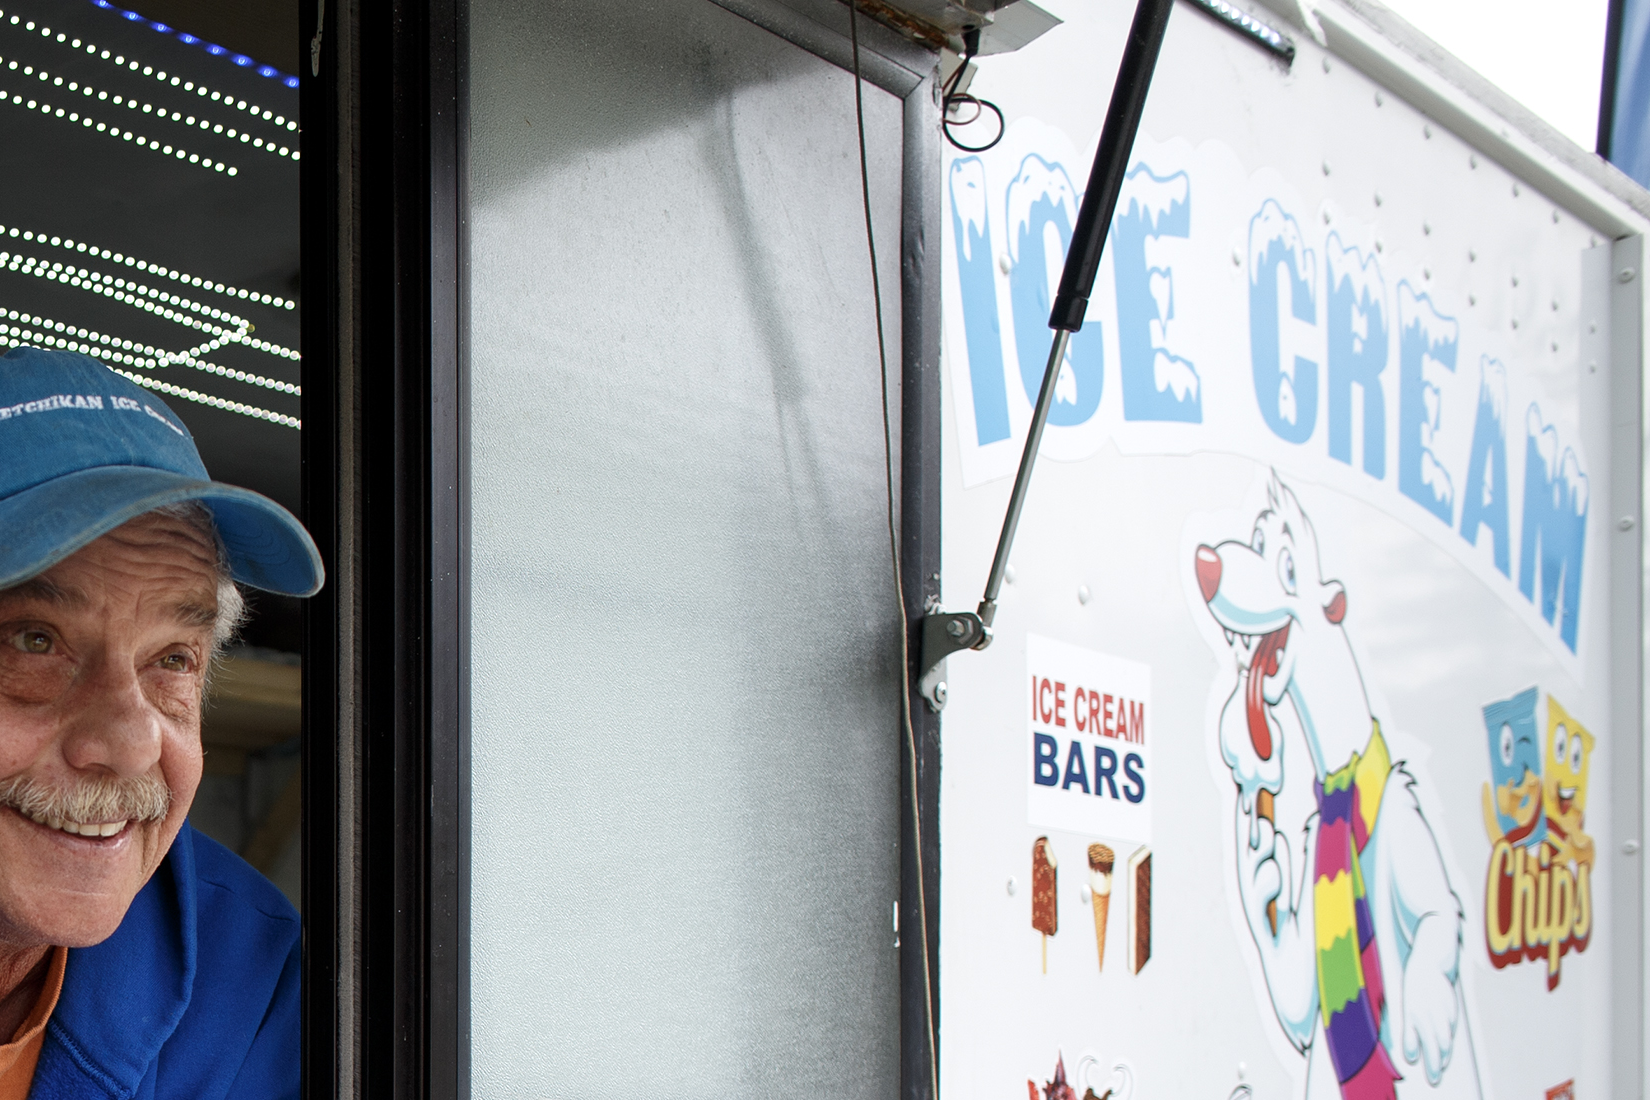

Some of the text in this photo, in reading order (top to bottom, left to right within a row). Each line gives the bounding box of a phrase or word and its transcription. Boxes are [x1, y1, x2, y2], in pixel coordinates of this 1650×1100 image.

[110, 395, 142, 412] ICE
[948, 152, 1589, 658] ICE CREAM
[1031, 674, 1145, 747] ICE CREAM
[1032, 730, 1146, 805] BARS
[1484, 839, 1591, 992] Chips
